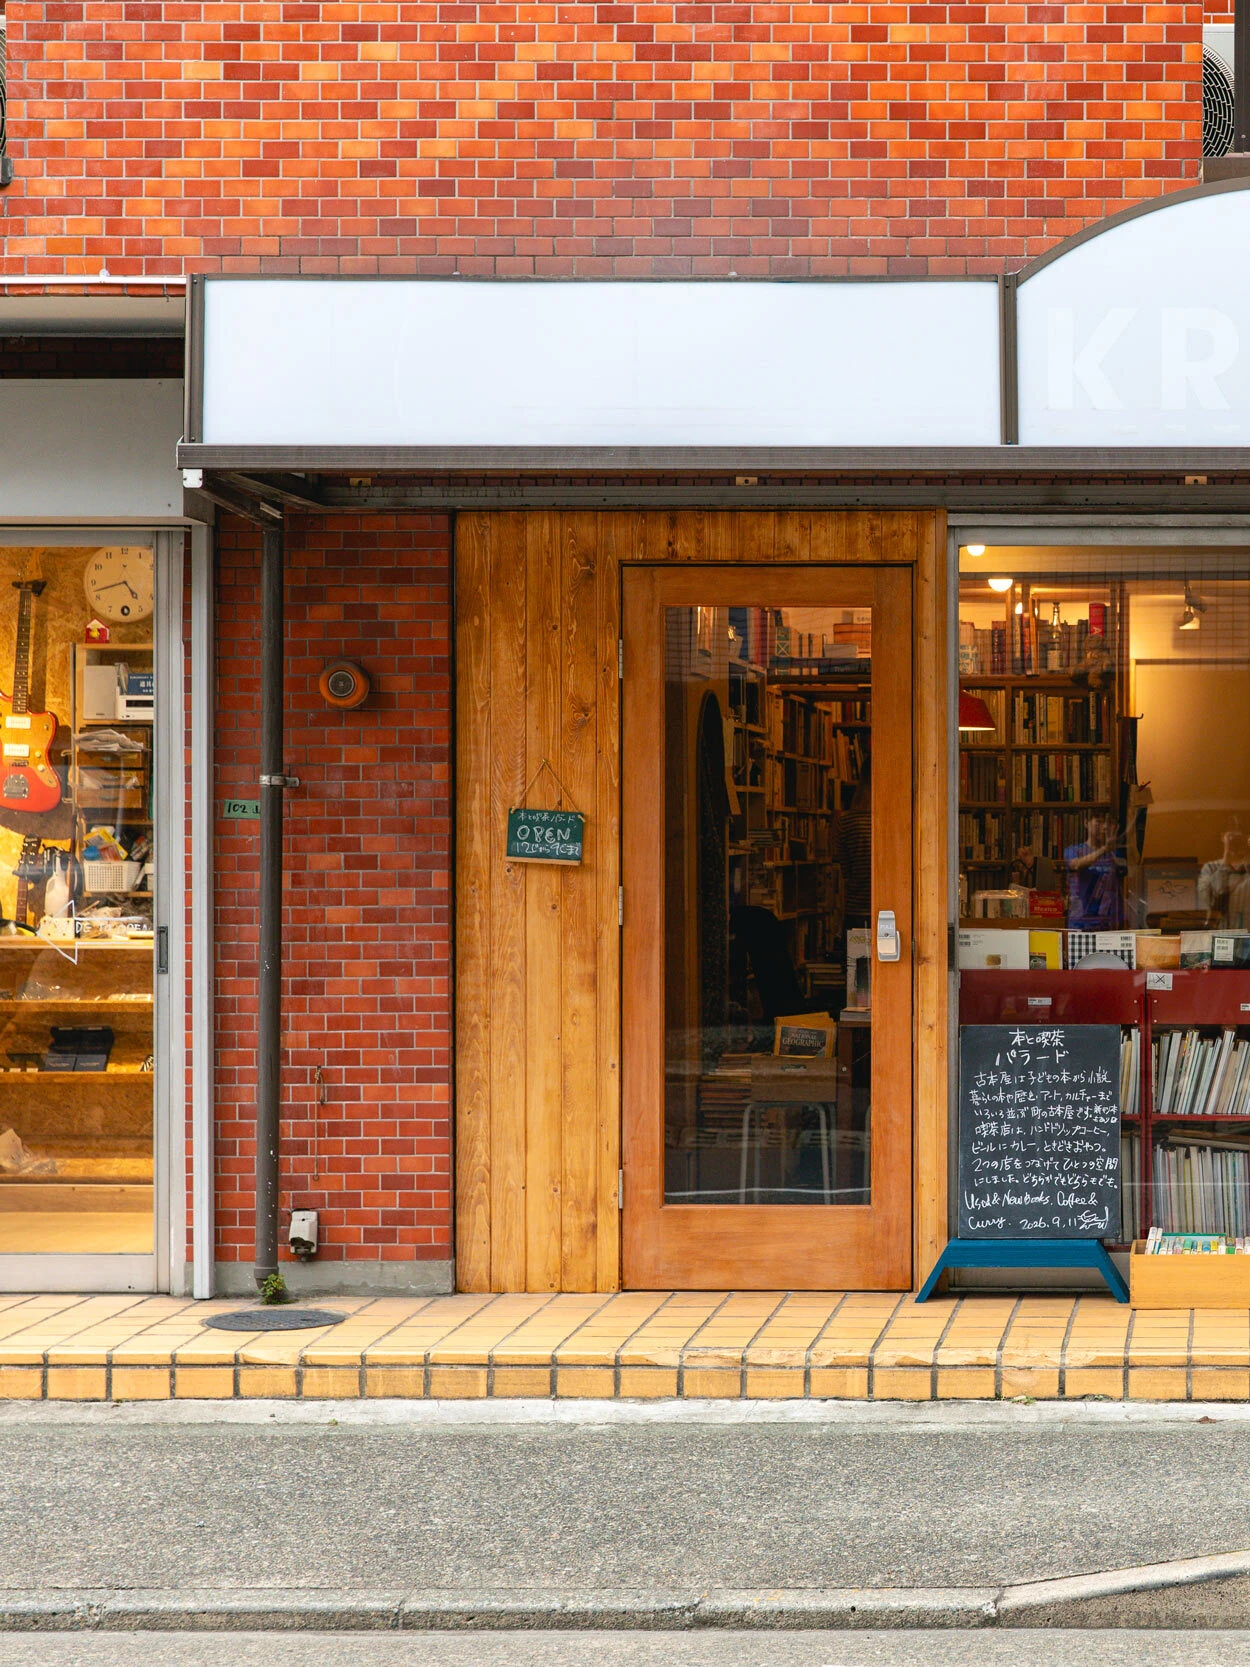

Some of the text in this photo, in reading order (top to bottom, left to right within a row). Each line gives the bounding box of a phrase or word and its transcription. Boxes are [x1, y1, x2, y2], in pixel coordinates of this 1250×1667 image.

[227, 802, 248, 814] 102
[517, 825, 571, 843] OPEN
[1008, 1027, 1066, 1048] 本と喫茶
[995, 1049, 1070, 1066] パラード
